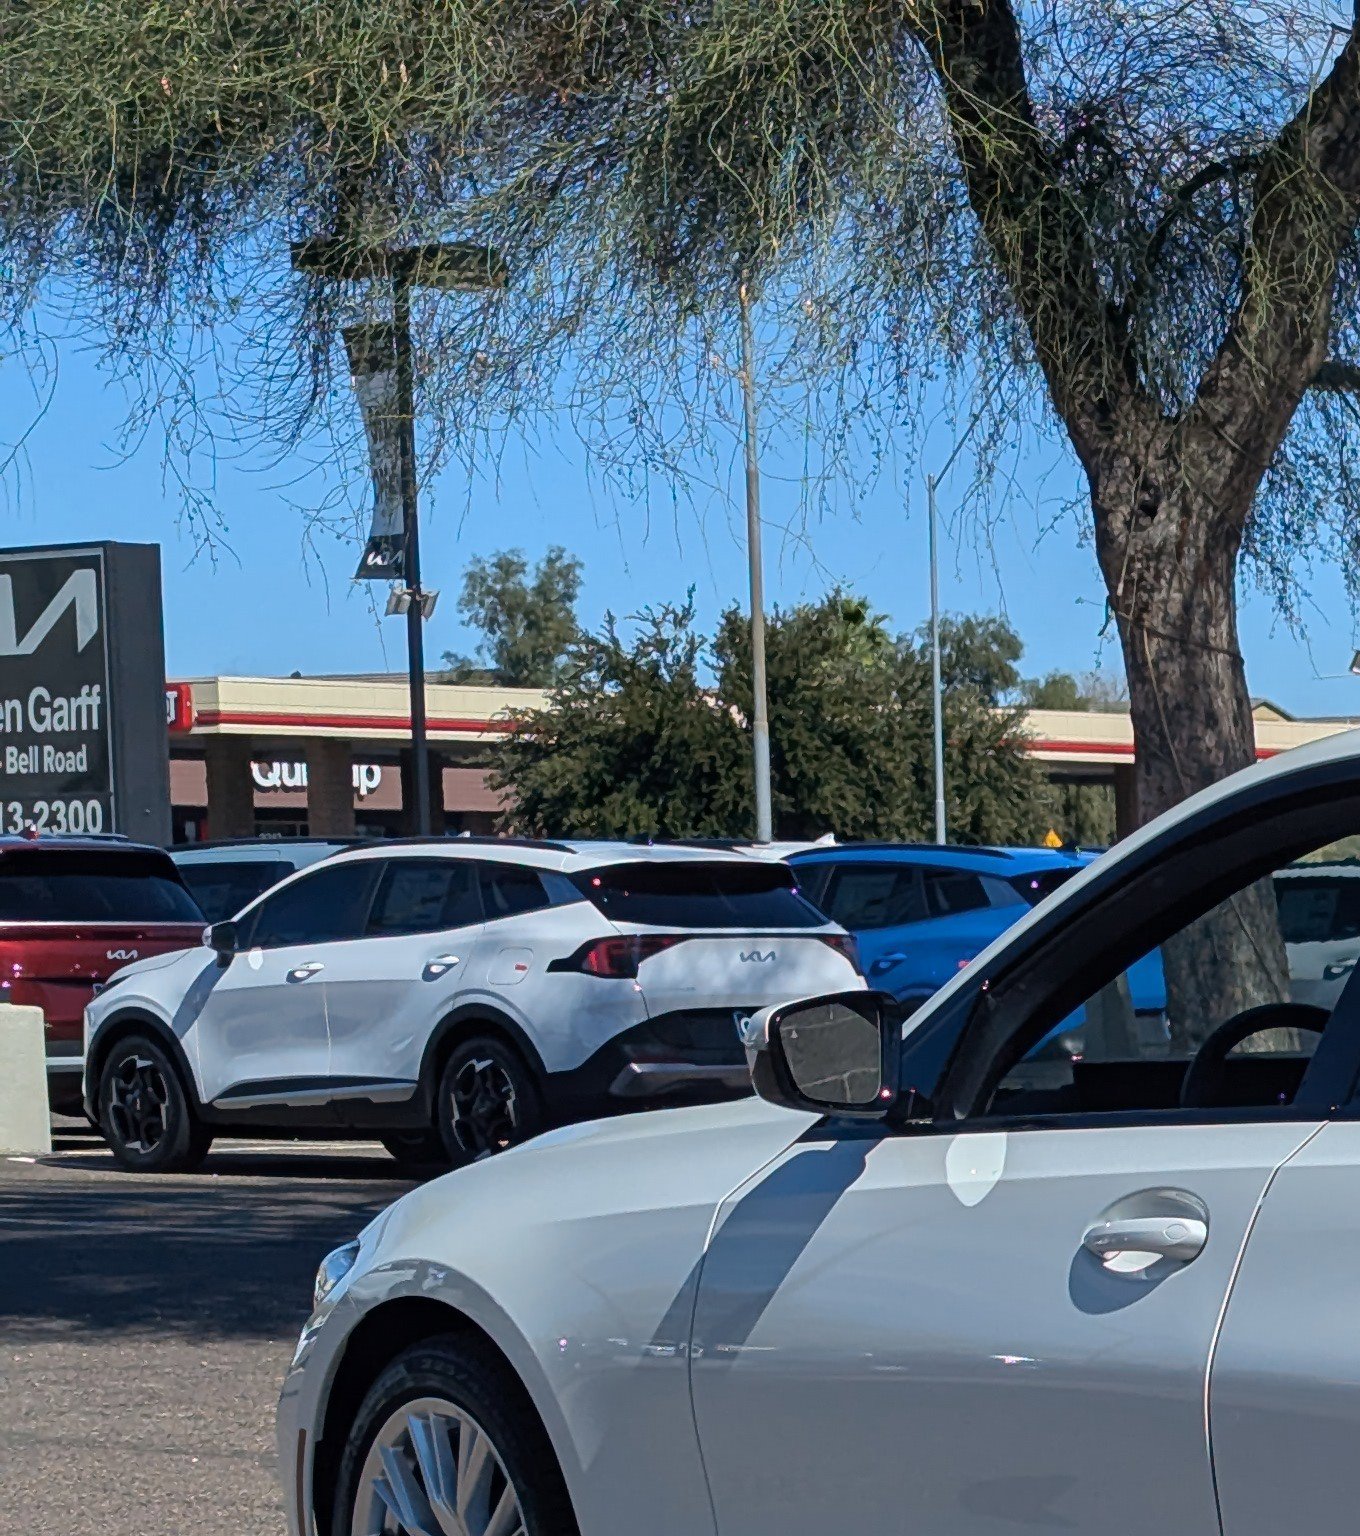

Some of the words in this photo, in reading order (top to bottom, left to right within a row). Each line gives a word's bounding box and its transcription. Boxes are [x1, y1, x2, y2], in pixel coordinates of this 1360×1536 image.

[28, 684, 101, 733] Garff
[5, 745, 39, 774] Bell
[43, 743, 88, 773] Road
